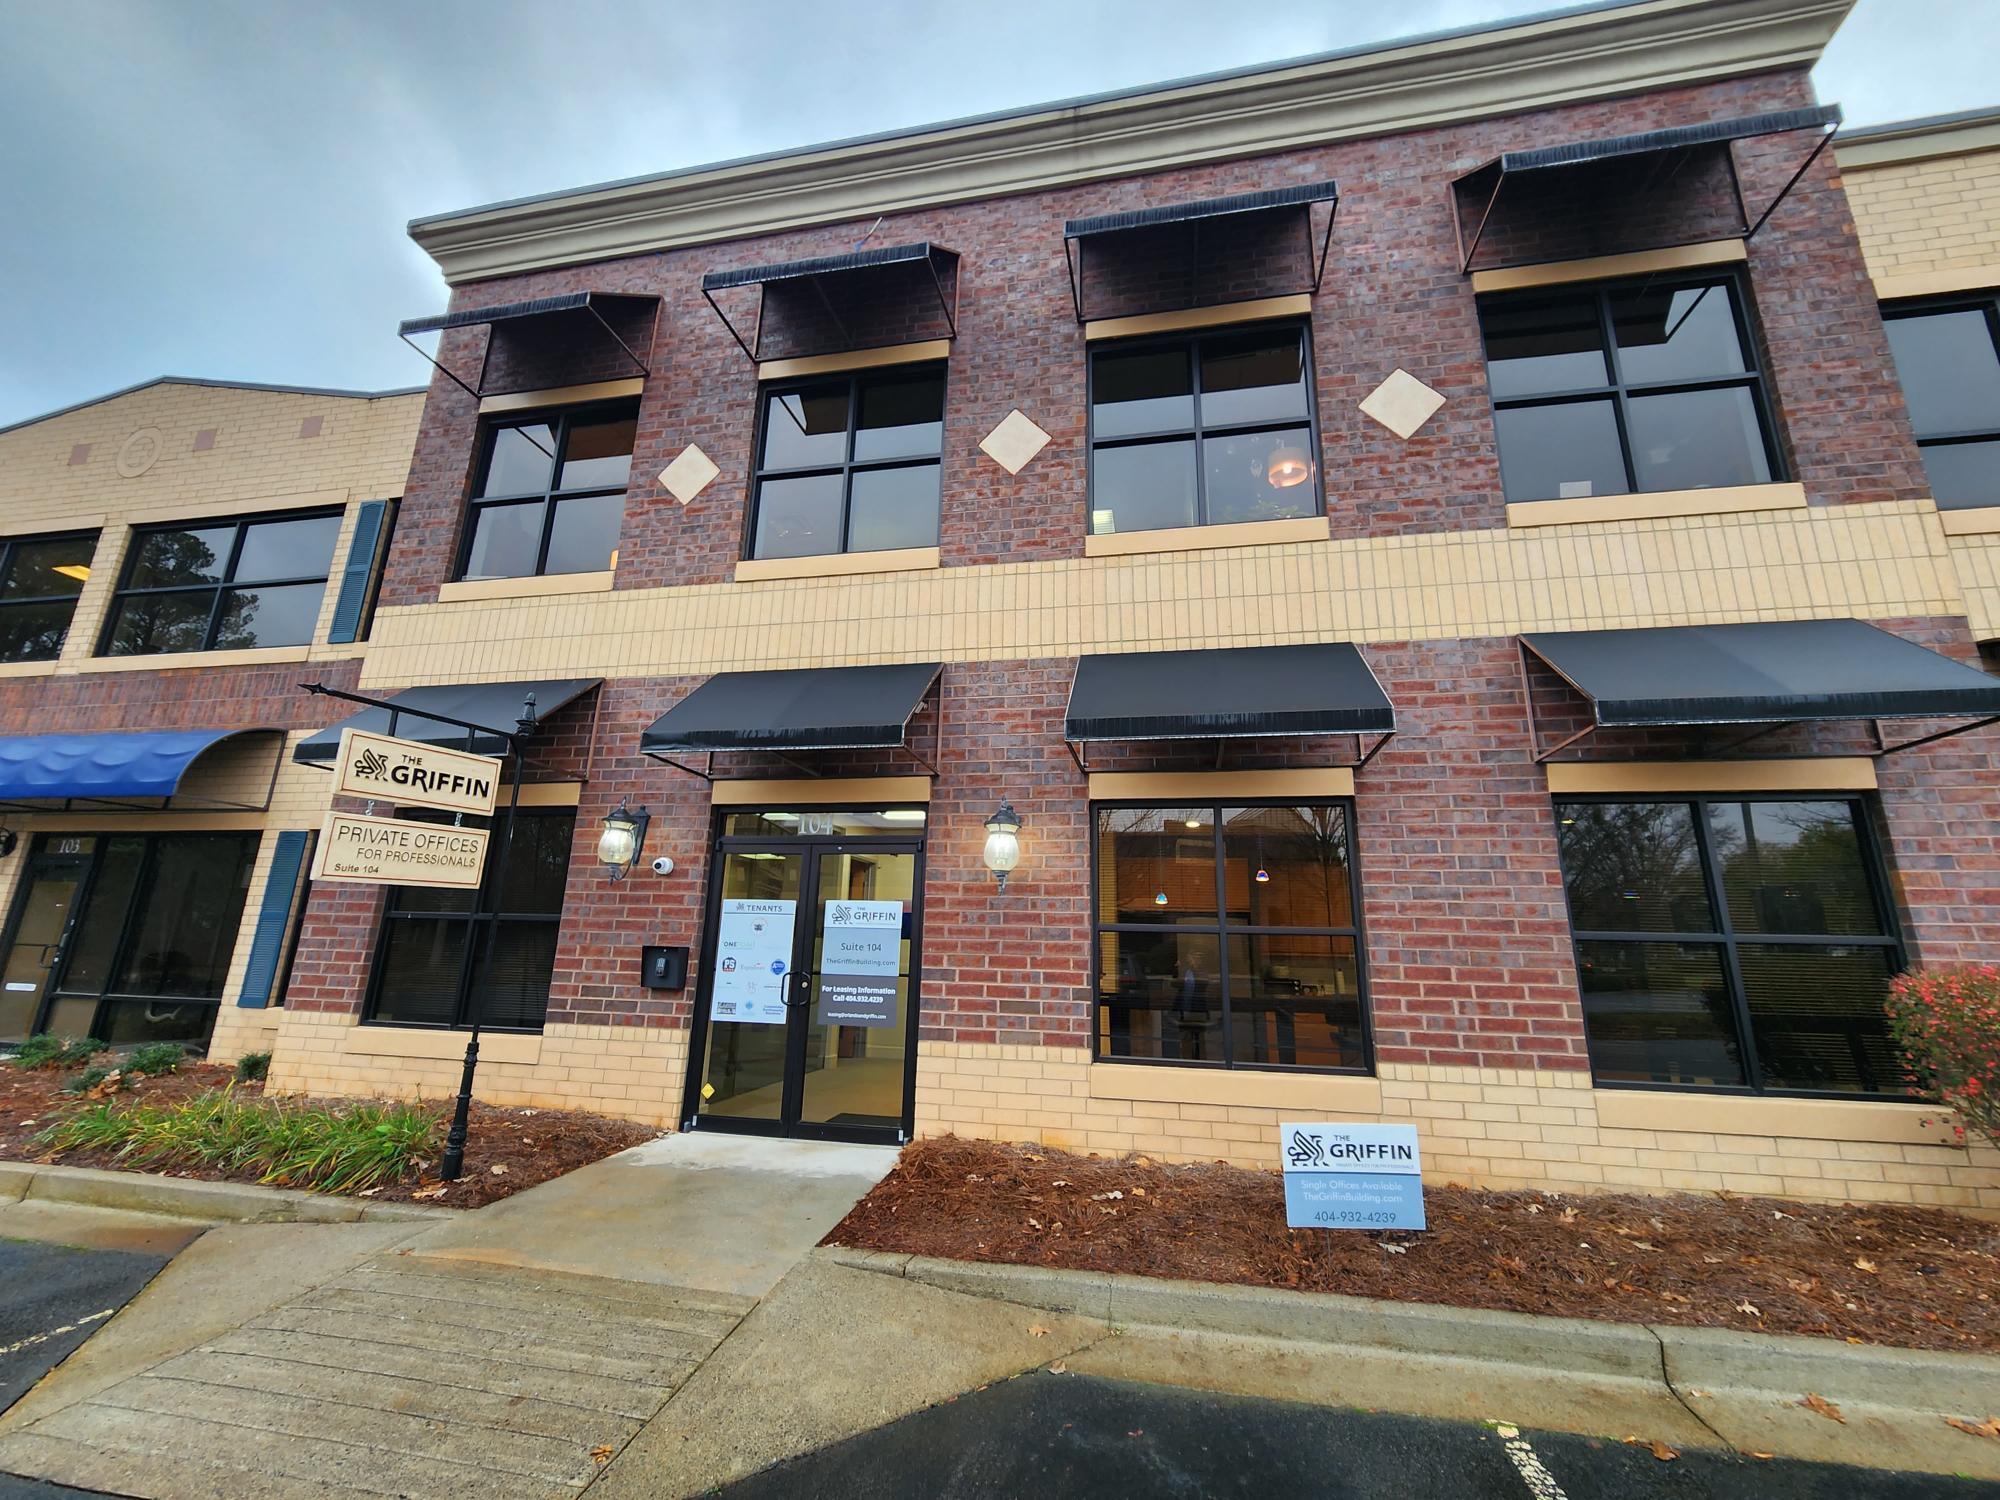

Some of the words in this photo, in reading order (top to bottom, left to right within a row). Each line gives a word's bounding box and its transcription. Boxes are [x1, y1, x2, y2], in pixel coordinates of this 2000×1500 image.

[402, 754, 423, 766] THE
[391, 766, 490, 798] GRIFFIN
[799, 813, 832, 835] 104
[338, 826, 410, 847] PRIVATE
[414, 834, 479, 853] OFFICES
[59, 839, 81, 853] 103
[357, 848, 382, 861] FOR
[385, 851, 476, 868] PROFESSIONALS
[334, 863, 360, 873] Suite
[362, 865, 379, 873] 104
[746, 904, 783, 913] TENANTS
[853, 911, 896, 922] GRIFFIN
[841, 942, 864, 951] Suite
[867, 943, 882, 952] 104
[826, 958, 896, 967] TheGriffinBuilding.com
[822, 985, 833, 993] For
[833, 986, 857, 995] Leasing
[857, 986, 896, 995] Information
[832, 994, 845, 1002] Call
[1329, 1143, 1413, 1162] GRIFFIN
[1301, 1180, 1327, 1191] Single
[1328, 1180, 1360, 1191] Offices
[1362, 1181, 1403, 1192] Available
[1303, 1191, 1403, 1204] TheGriffinBuilding.com
[1314, 1211, 1396, 1223] 404-932-4239
